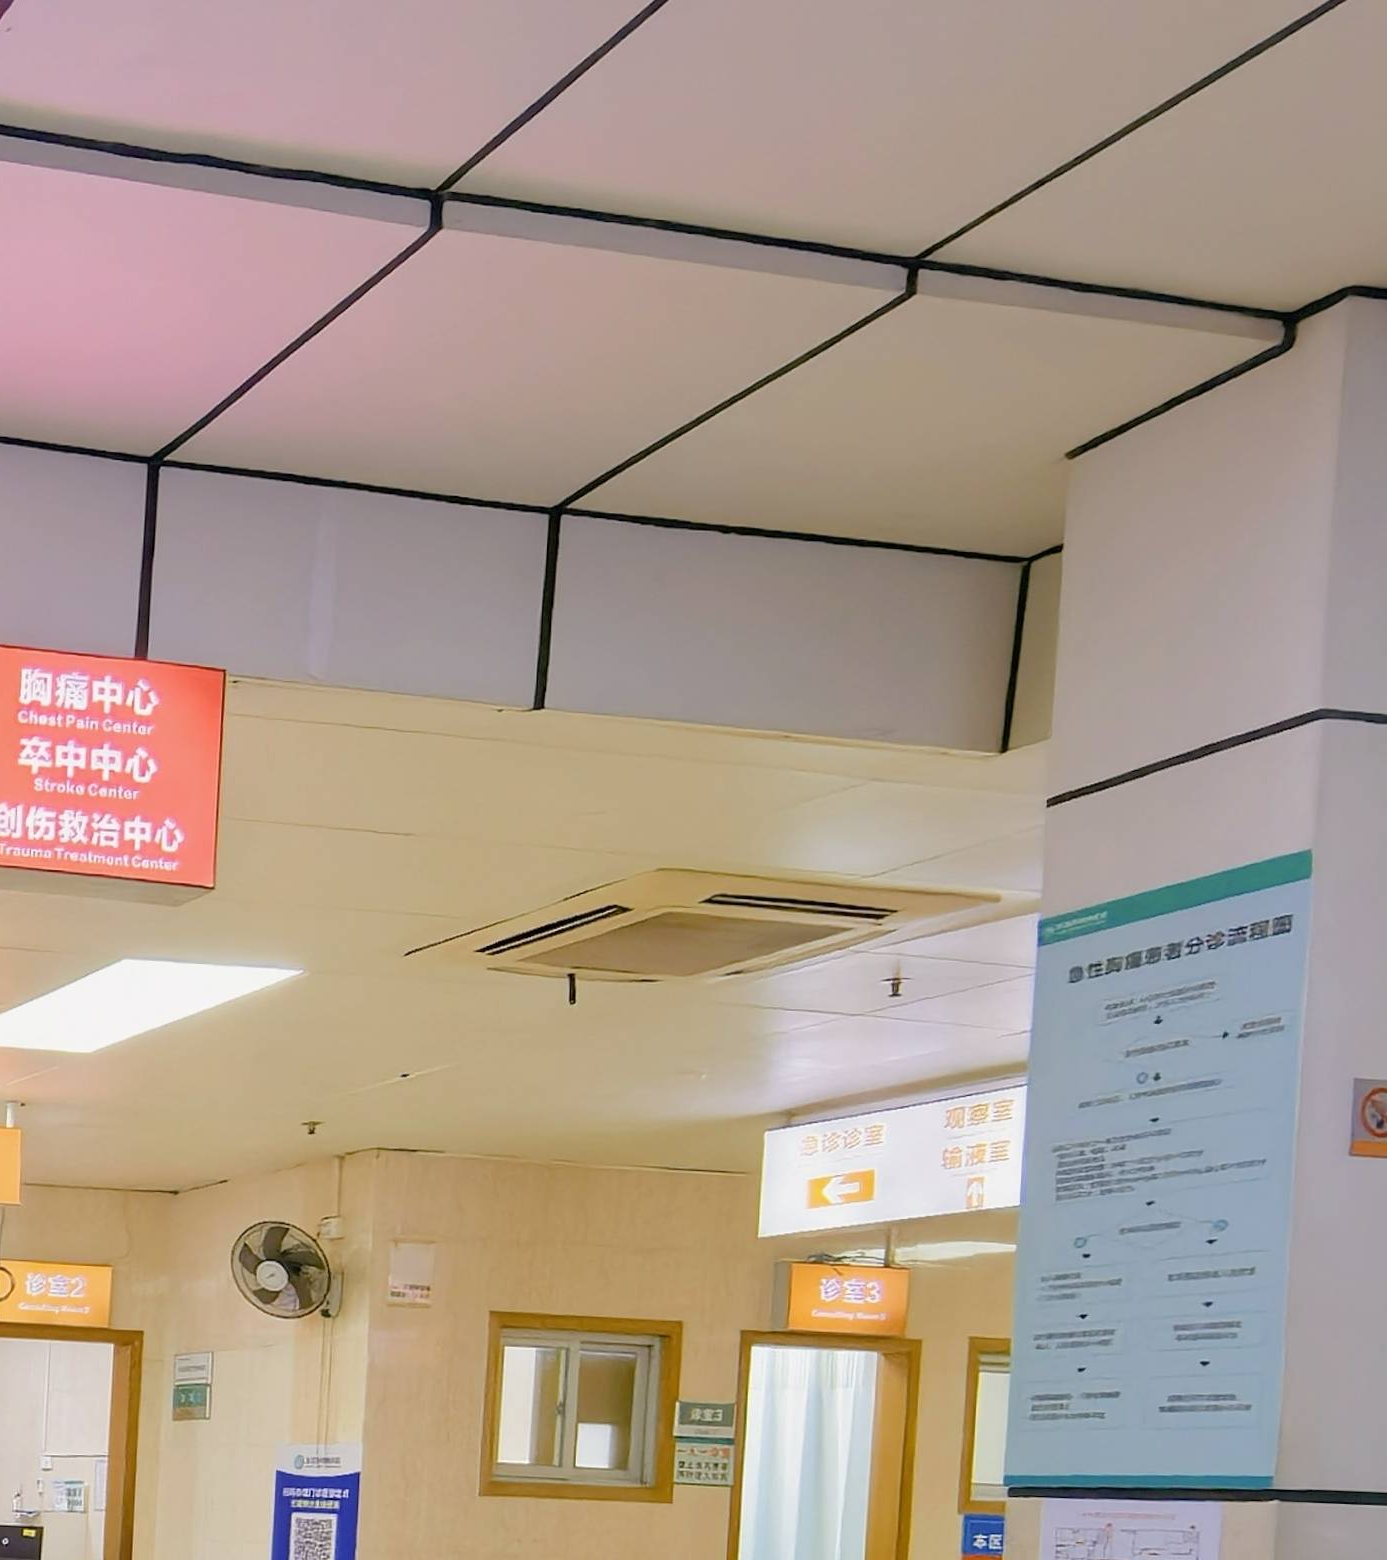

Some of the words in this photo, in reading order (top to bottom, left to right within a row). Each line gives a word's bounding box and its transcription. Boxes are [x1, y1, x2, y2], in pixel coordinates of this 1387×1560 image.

[18, 667, 160, 717] 胸痛中心
[17, 710, 63, 729] Chest
[65, 714, 99, 731] Pain
[102, 718, 155, 736] Center
[18, 735, 159, 784] 卒中中心
[33, 777, 85, 796] Stroke
[87, 783, 140, 801] Center
[800, 1123, 885, 1157] 急诊诊室
[25, 1271, 86, 1298] 诊室2
[819, 1277, 882, 1305] 诊室3
